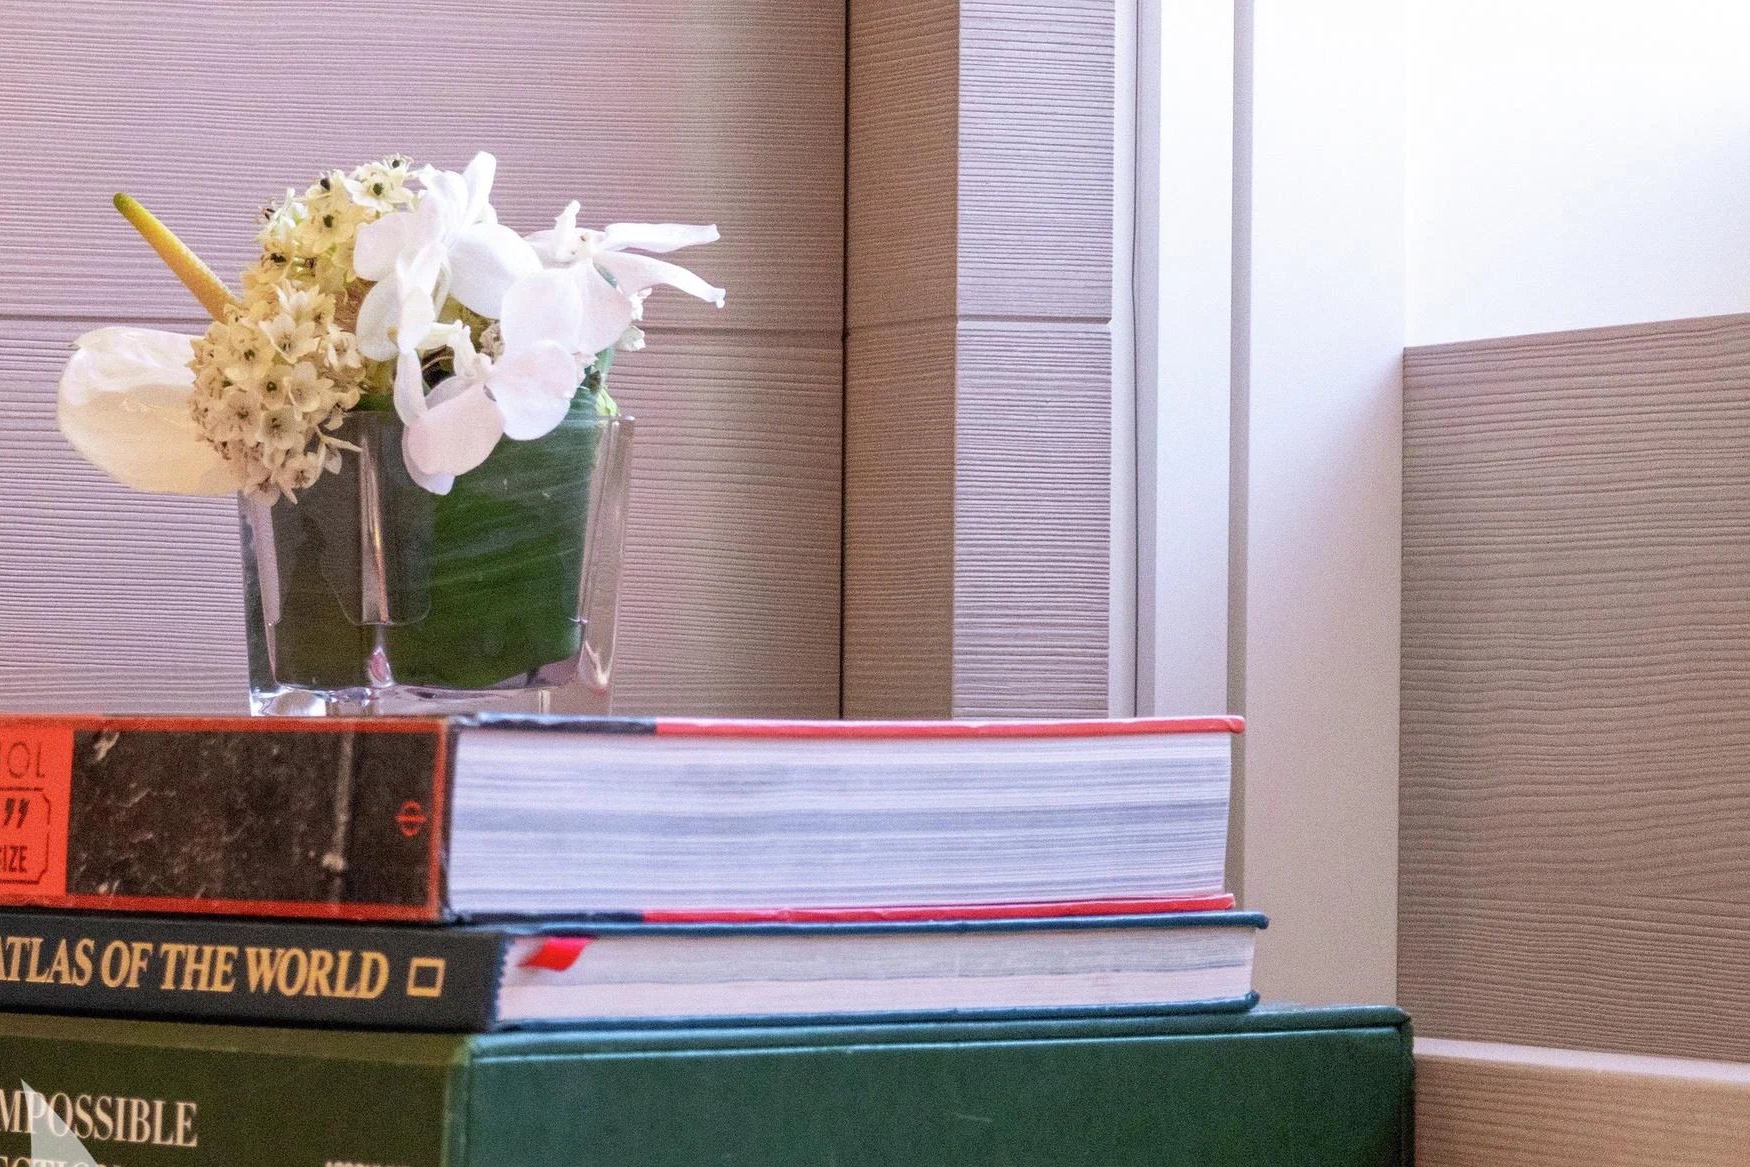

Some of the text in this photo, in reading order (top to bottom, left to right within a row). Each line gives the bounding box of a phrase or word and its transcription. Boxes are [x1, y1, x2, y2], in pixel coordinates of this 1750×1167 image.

[100, 939, 153, 988] OF
[159, 943, 239, 993] THE
[245, 947, 390, 999] WORLD
